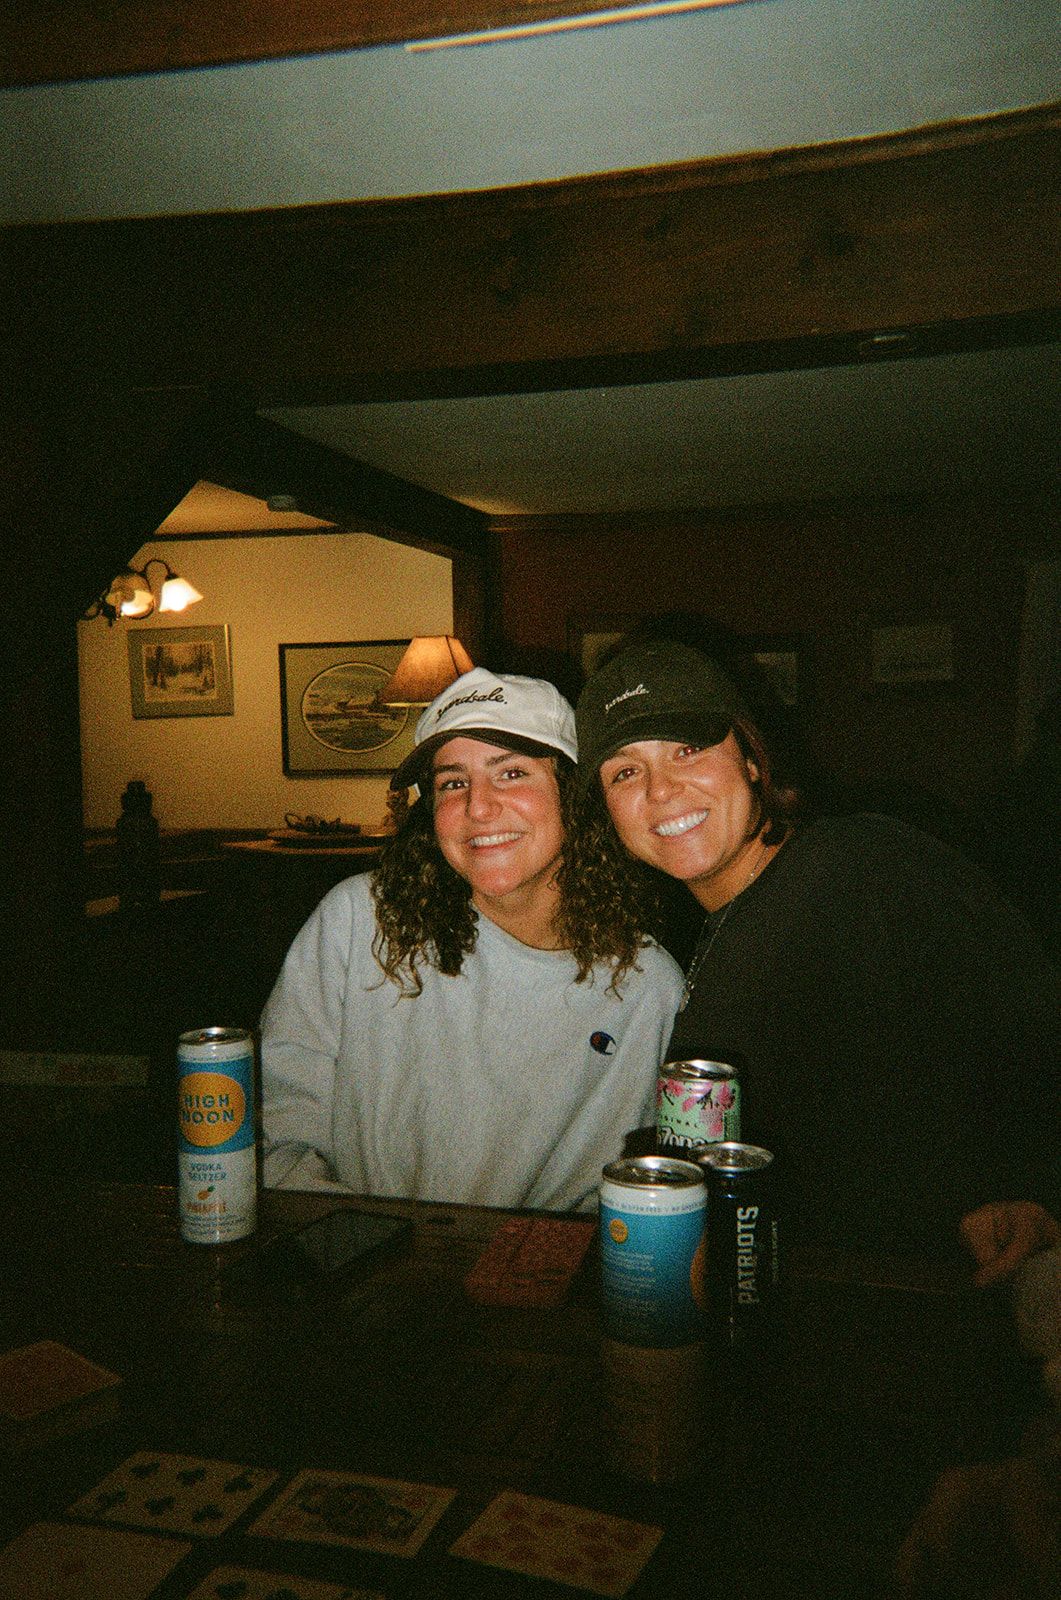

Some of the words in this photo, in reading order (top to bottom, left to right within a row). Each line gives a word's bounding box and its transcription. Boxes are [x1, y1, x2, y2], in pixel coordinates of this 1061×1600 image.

[184, 1093, 230, 1109] HIGH
[181, 1109, 235, 1124] NOON
[190, 1162, 223, 1172] VODKA
[187, 1171, 228, 1182] SELTZER
[736, 1205, 760, 1304] PATRIOTS
